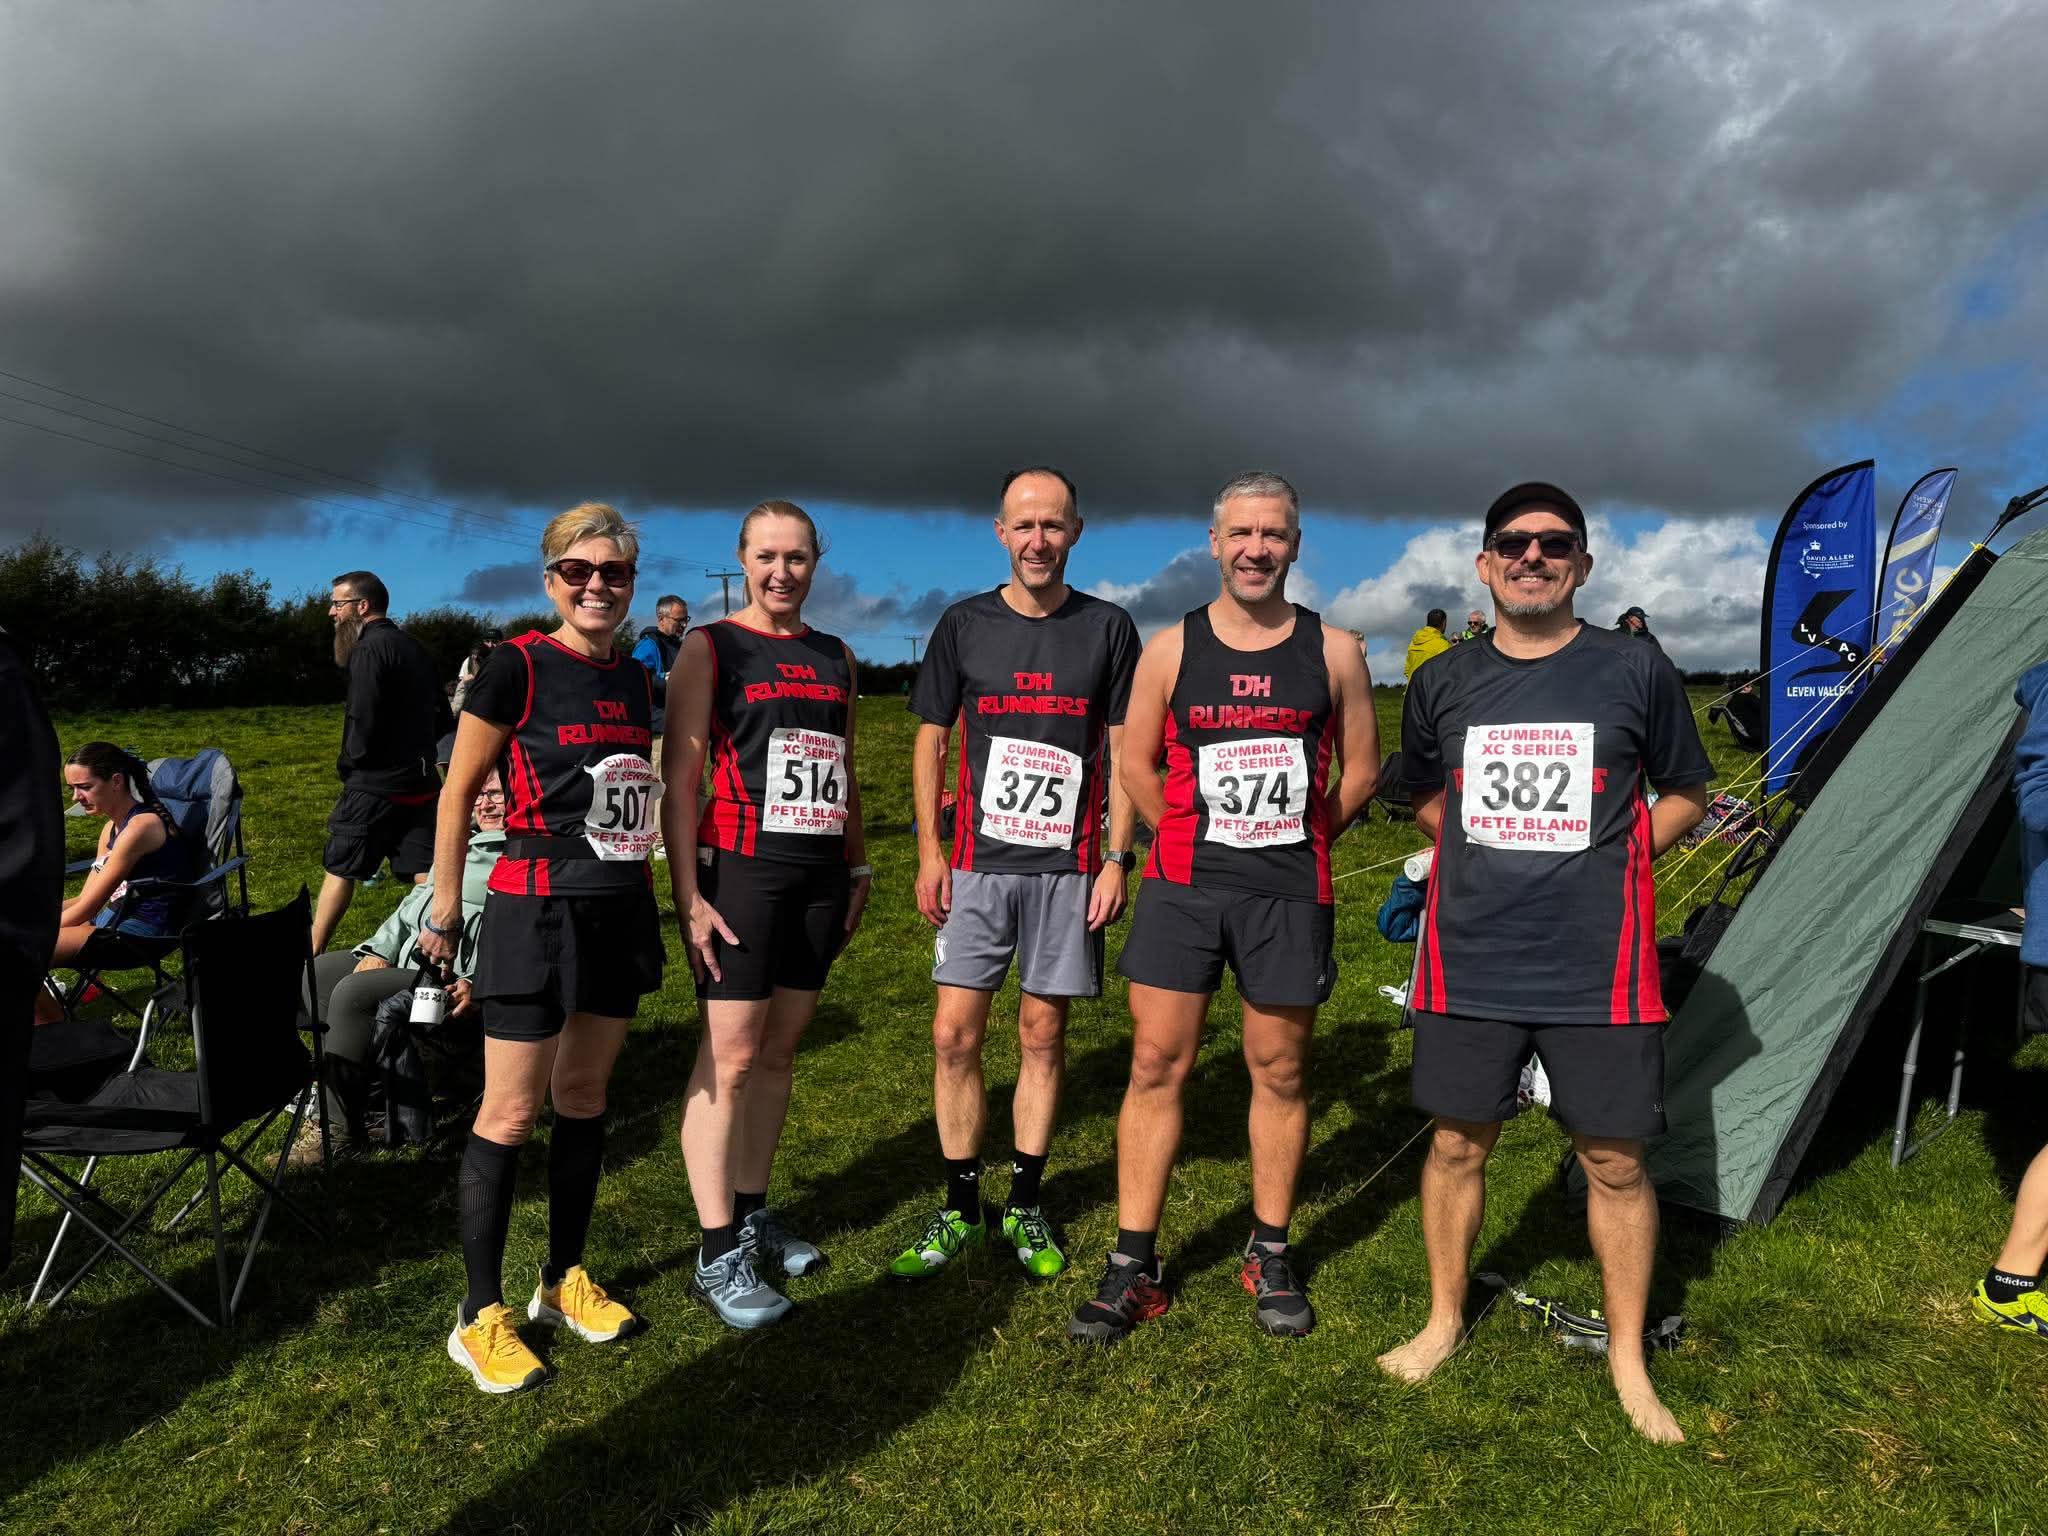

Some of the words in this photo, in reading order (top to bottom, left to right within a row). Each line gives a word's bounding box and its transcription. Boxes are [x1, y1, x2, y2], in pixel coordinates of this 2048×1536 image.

[1802, 521, 1837, 530] Sponsored
[1838, 521, 1848, 529] by
[776, 664, 817, 680] DH
[1014, 672, 1053, 690] DH
[1230, 674, 1272, 697] DH
[1787, 686, 1815, 697] LEVEN
[977, 696, 1089, 716] RUNNERS
[1189, 705, 1312, 733] RUNNERS
[557, 723, 653, 746] RUNNER
[786, 732, 837, 750] CUMBRIA
[1488, 729, 1573, 741] CUMBRIA
[782, 744, 801, 755] XC
[804, 746, 840, 762] SERIES
[1007, 743, 1069, 764] CUMBRIA
[1217, 743, 1289, 759] CUMBRIA
[1481, 744, 1505, 756] XC
[1511, 744, 1578, 757] SERIES
[1001, 755, 1020, 766] XC
[1023, 758, 1072, 776] SERIES
[1214, 760, 1233, 772] XC
[1239, 756, 1294, 770] SERIES
[605, 770, 617, 783] XC
[621, 771, 660, 783] SERIES
[781, 760, 839, 804] 516
[996, 770, 1065, 818] 375
[1218, 771, 1291, 816] 374
[1481, 761, 1571, 813] 382
[599, 786, 652, 832] 507
[771, 805, 808, 818] PETE
[812, 808, 848, 822] BLAND
[793, 818, 832, 829] SPORTS
[986, 813, 1020, 828] PETE
[1025, 819, 1072, 834] BLAND
[1215, 818, 1249, 832] PETE
[1254, 817, 1301, 831] BLAND
[1470, 816, 1517, 829] PETE
[1523, 818, 1588, 832] BLAND
[591, 831, 629, 842] PETE
[1005, 828, 1048, 841] SPORTS
[1236, 831, 1278, 841] SPORTS
[1499, 831, 1556, 843] SPORTS
[614, 843, 650, 852] SPORTS
[1995, 1274, 2035, 1288] adidas
